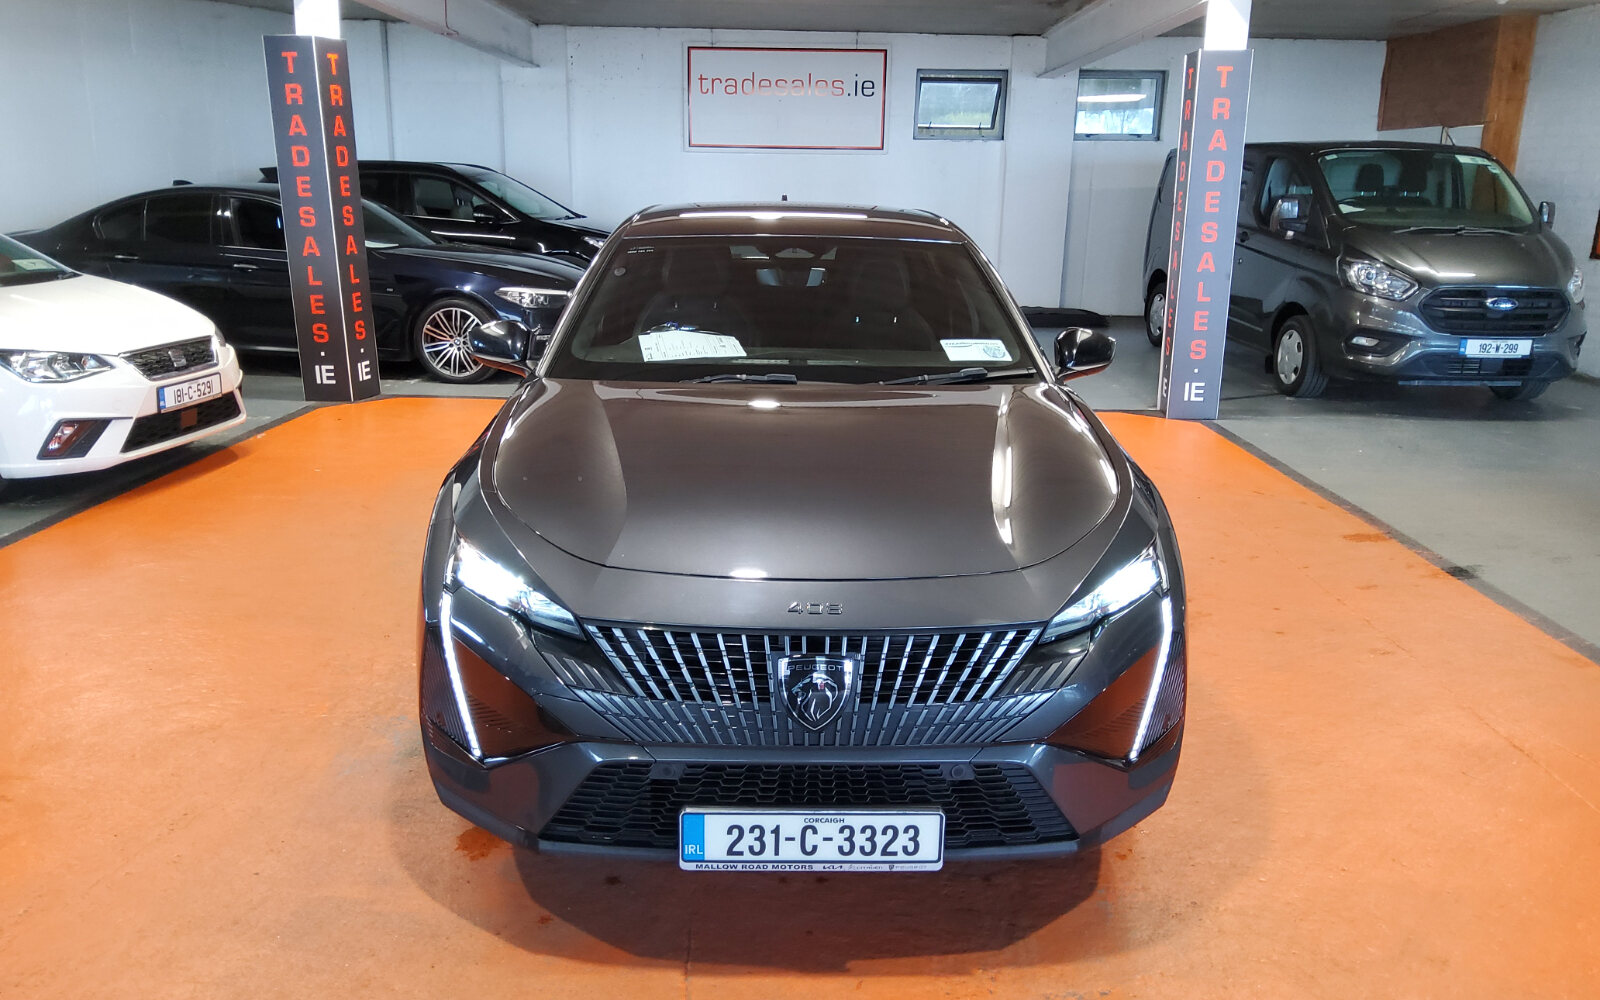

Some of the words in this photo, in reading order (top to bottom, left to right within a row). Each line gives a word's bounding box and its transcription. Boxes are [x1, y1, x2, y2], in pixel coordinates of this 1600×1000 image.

[697, 71, 876, 98] tradesales.ie
[1478, 343, 1519, 354] 192-W-299
[173, 379, 214, 405] 181-C-5291
[787, 601, 844, 615] 408
[787, 664, 844, 672] PEUGEOT
[726, 824, 921, 857] 231-C-3323
[684, 844, 704, 855] IRL
